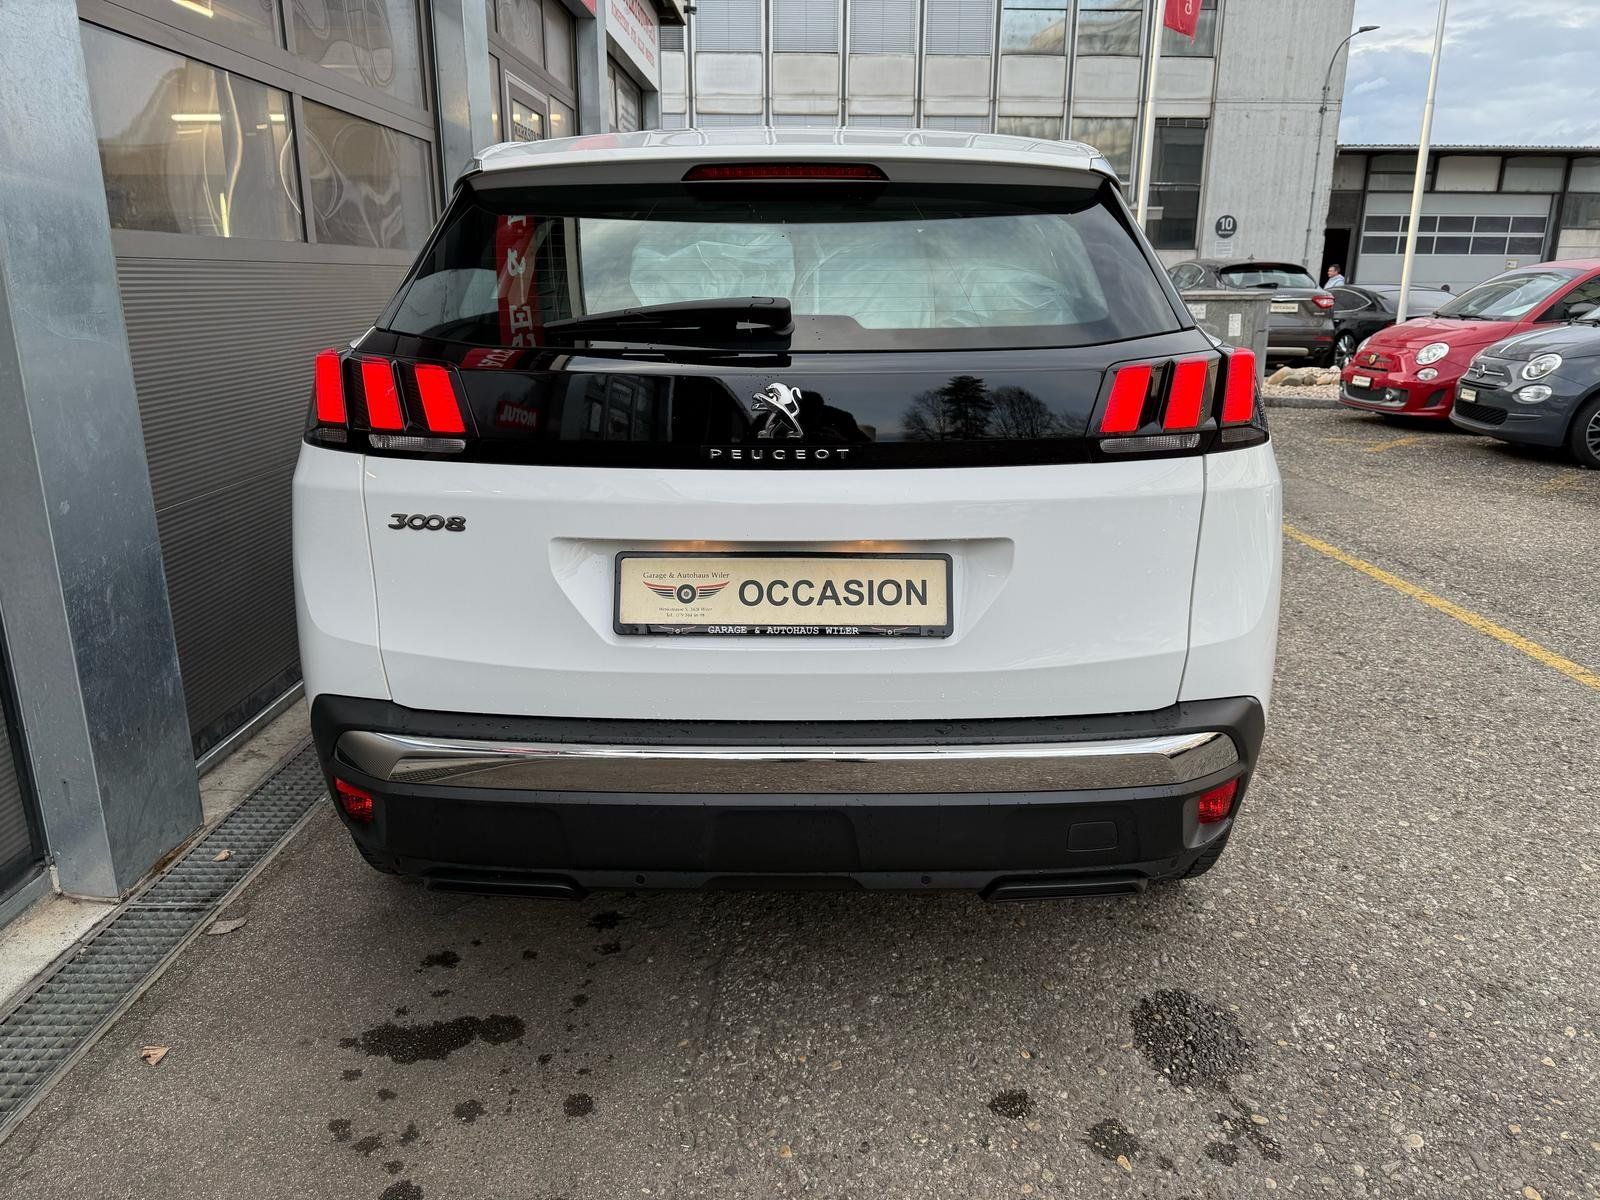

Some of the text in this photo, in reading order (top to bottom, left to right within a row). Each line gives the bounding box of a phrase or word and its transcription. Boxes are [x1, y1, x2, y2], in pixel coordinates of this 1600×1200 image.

[1219, 217, 1234, 230] 10
[709, 448, 850, 460] PEUGEOT
[387, 513, 467, 532] 3008
[642, 571, 730, 580] Garage & Autohaus Wiler
[738, 579, 928, 606] OCCASION
[707, 626, 859, 635] GARAGE & AUTOHAUS WILER
